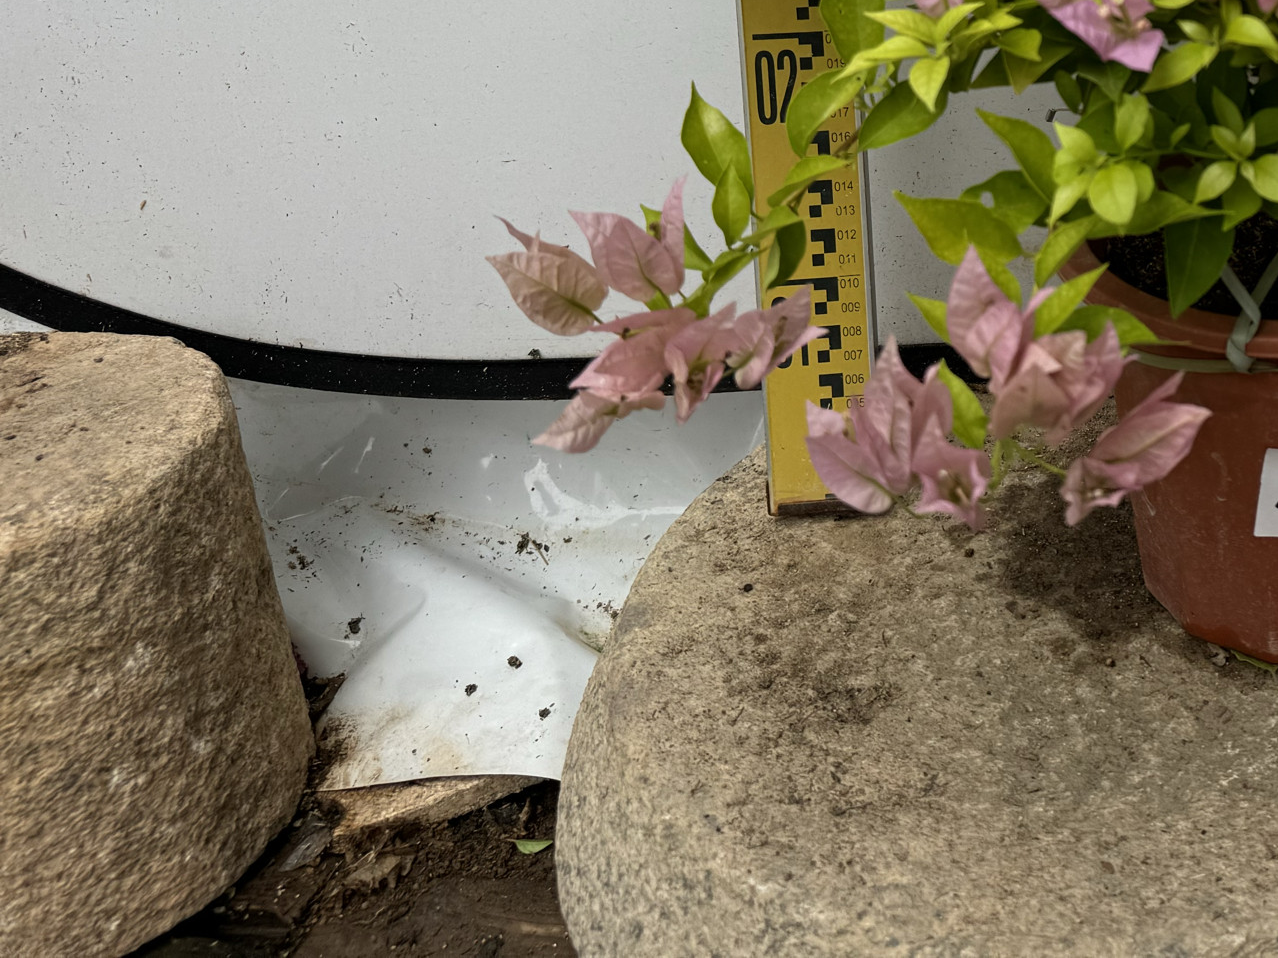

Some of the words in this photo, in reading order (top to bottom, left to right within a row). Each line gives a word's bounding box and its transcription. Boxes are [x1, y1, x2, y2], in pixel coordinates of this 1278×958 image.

[754, 50, 797, 126] 02
[832, 131, 850, 143] 016
[835, 181, 853, 191] 014
[836, 205, 855, 216] 013
[837, 229, 856, 240] 012
[839, 254, 857, 264] 011
[840, 277, 859, 288] 010
[842, 302, 860, 312] 009
[843, 326, 861, 336] 008
[844, 350, 862, 360] 007
[845, 374, 864, 384] 006
[847, 398, 865, 409] 05
